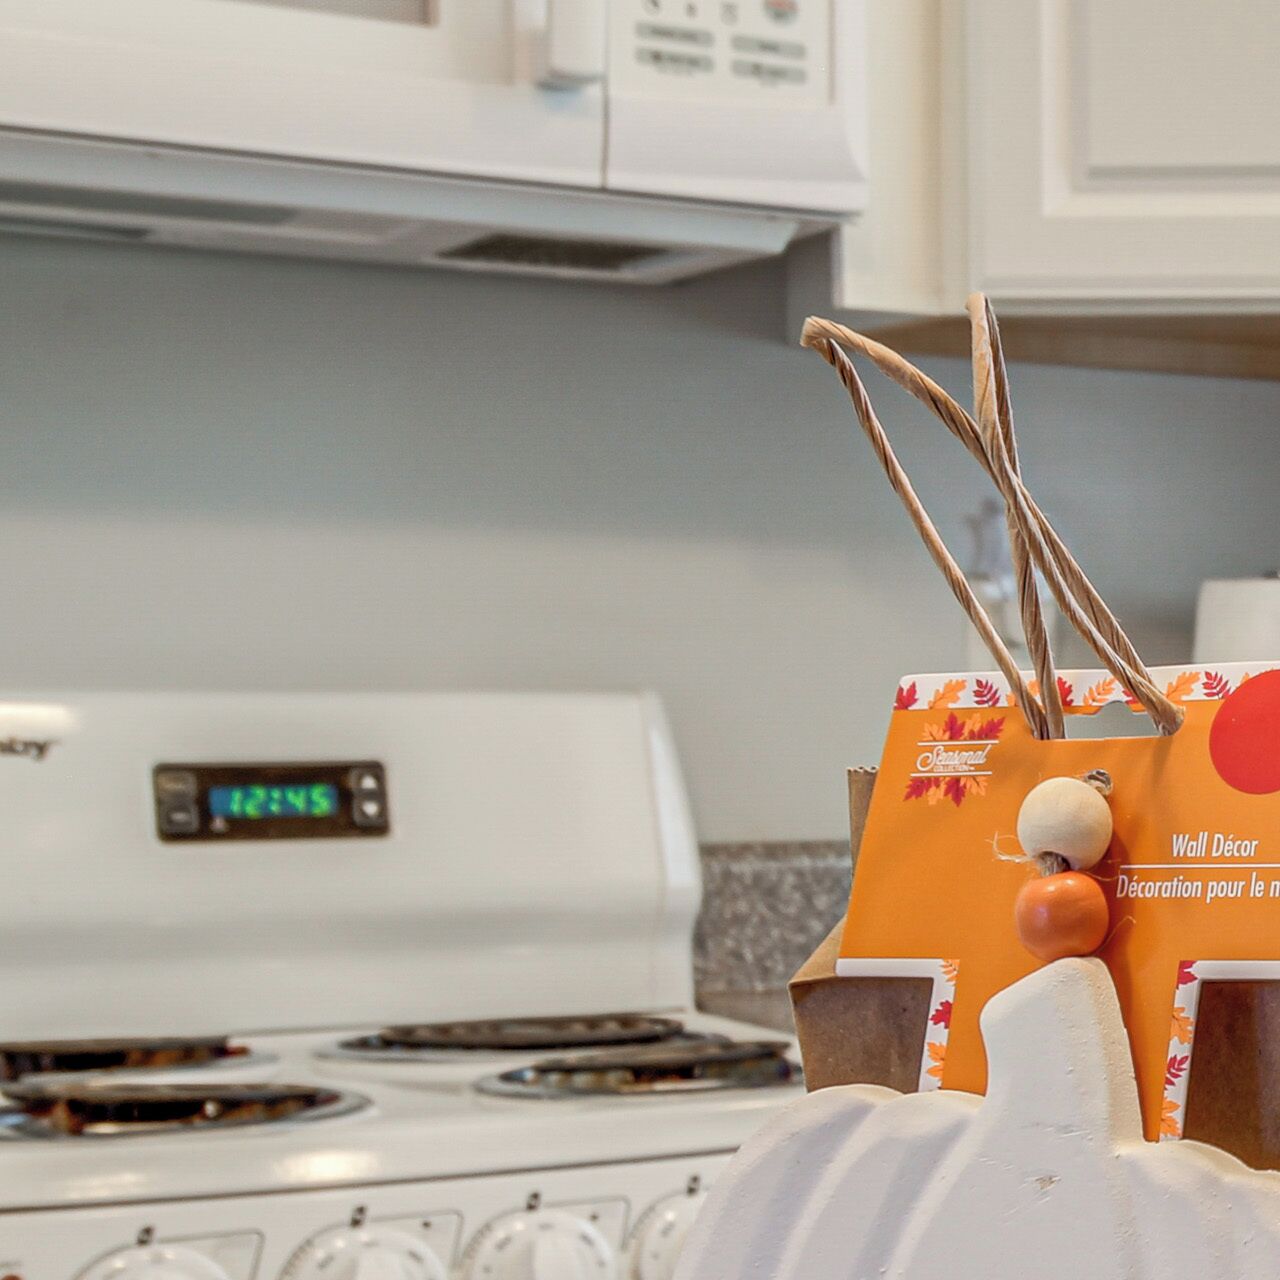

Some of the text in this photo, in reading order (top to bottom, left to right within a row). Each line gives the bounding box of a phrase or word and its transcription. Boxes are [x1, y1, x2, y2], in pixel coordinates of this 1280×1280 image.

[916, 744, 993, 771] Seasonal
[230, 784, 333, 819] 12:45
[1172, 831, 1259, 858] Wall Décor
[1116, 874, 1202, 900] Décoration
[1205, 878, 1246, 905] pour
[1250, 871, 1265, 899] le
